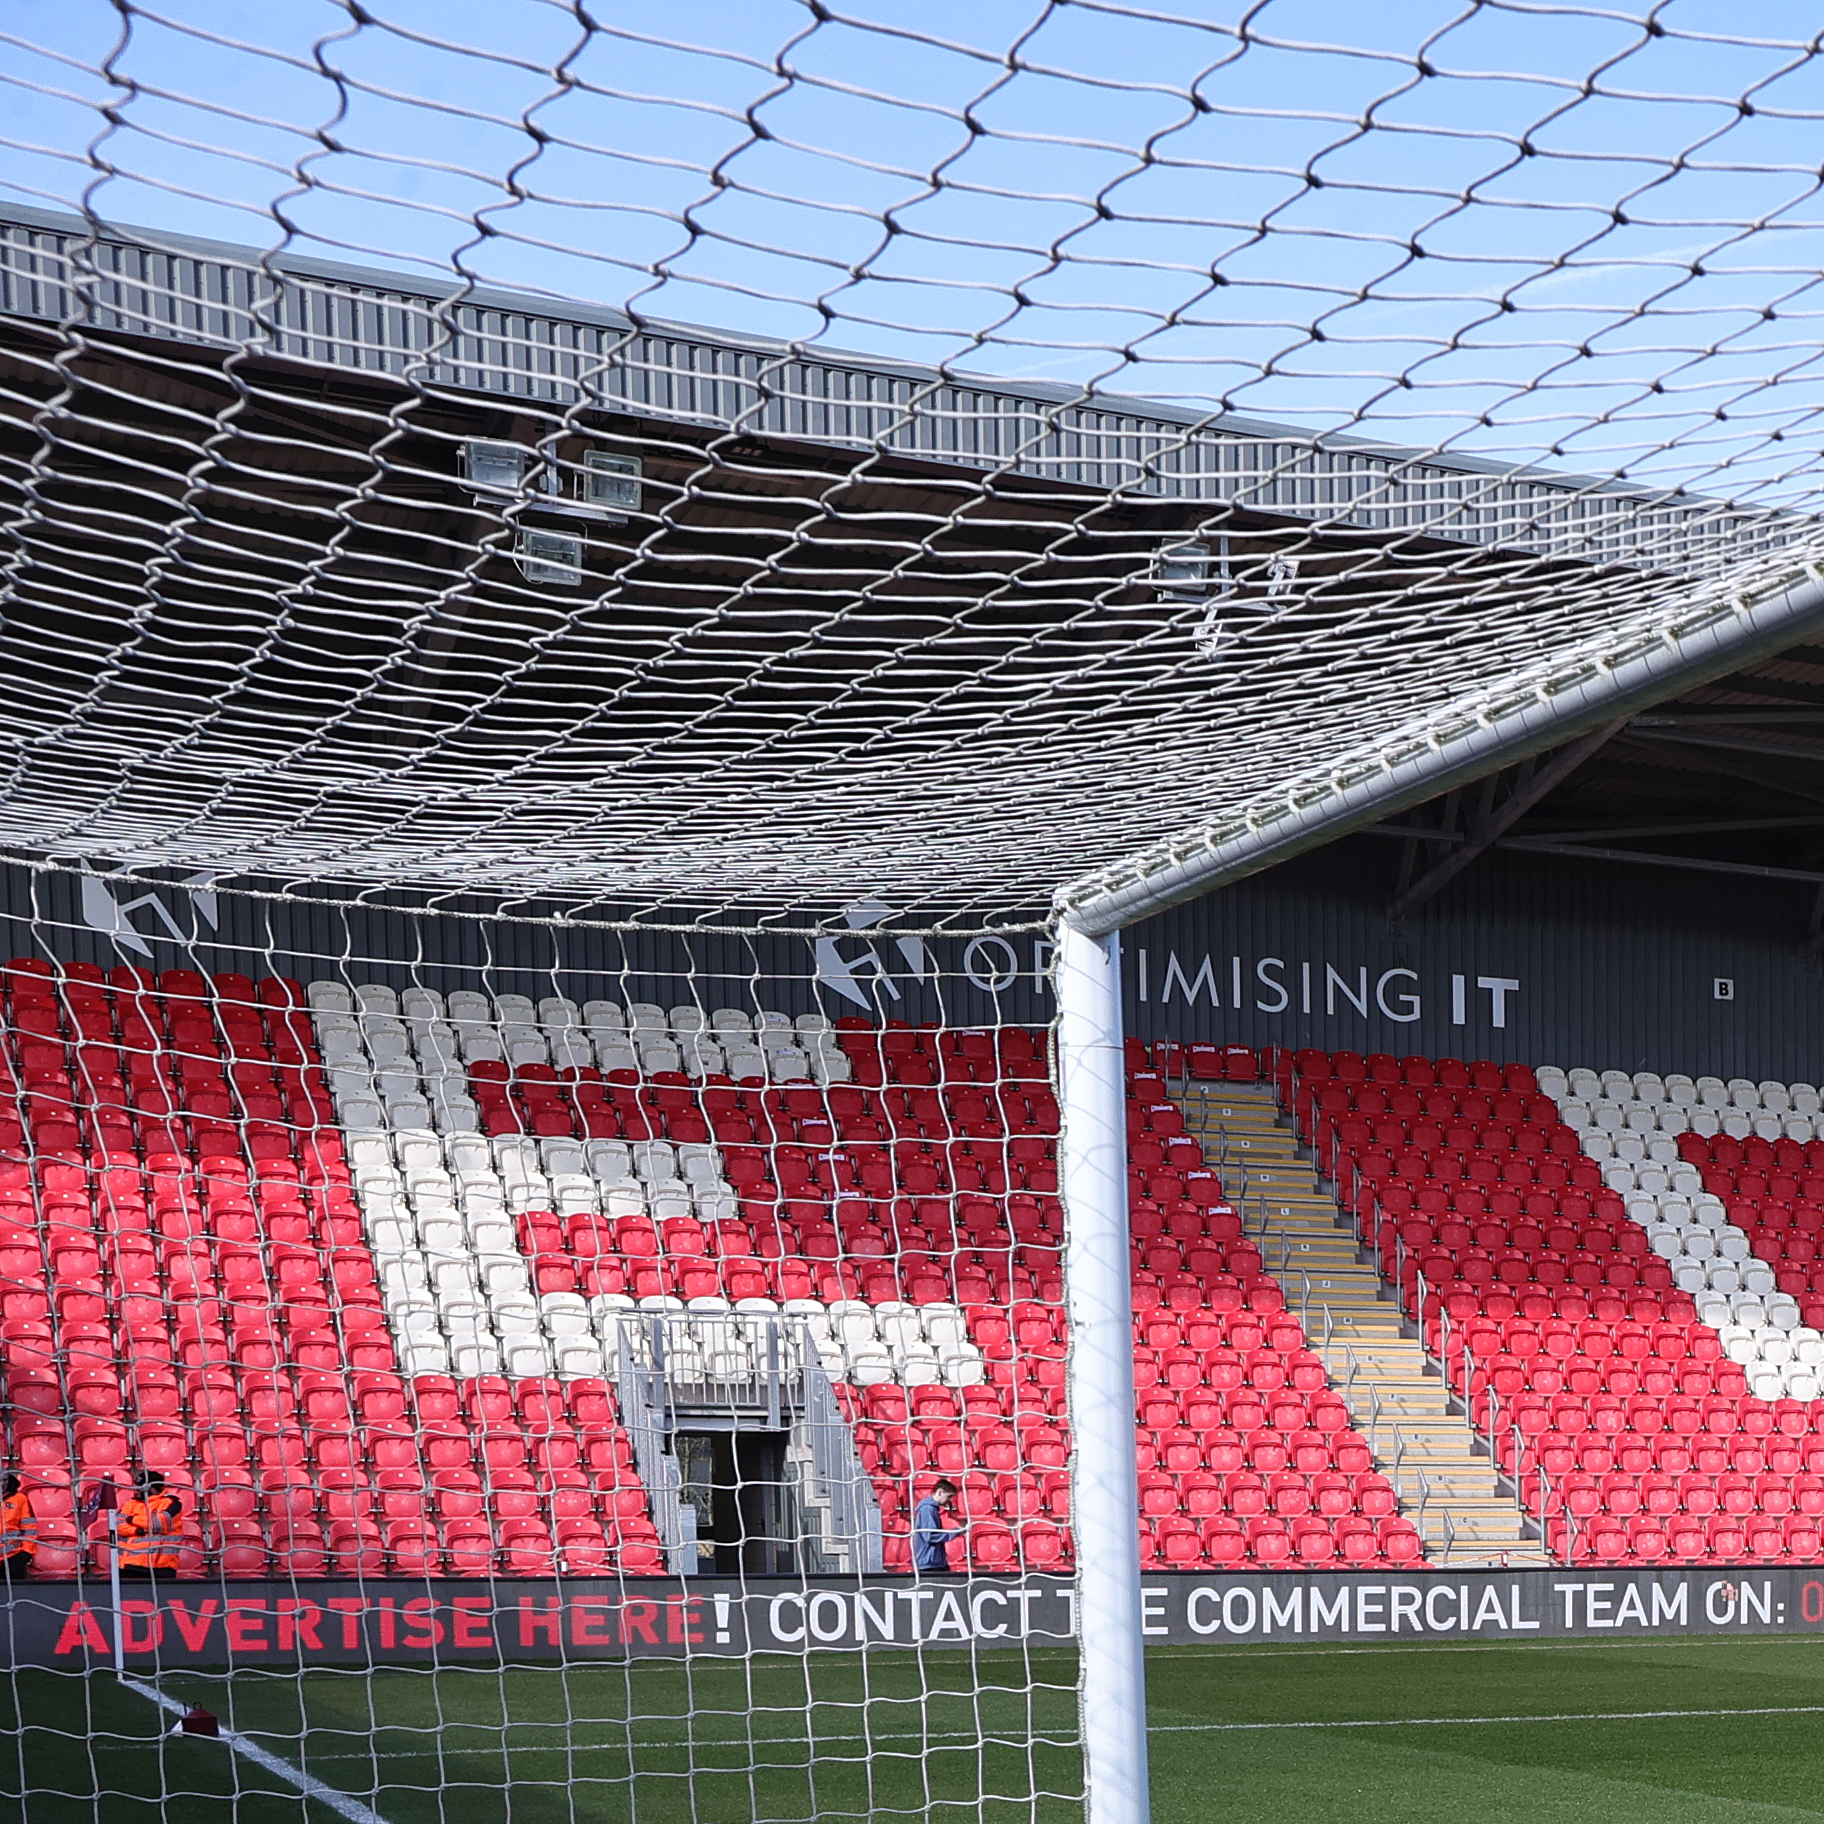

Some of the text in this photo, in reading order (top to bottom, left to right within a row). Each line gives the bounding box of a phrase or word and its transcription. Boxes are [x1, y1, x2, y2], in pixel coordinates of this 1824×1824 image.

[963, 935, 1520, 1029] OIMISING IT
[1718, 982, 1729, 997] B
[54, 1596, 496, 1655] ADVERTISE
[517, 1593, 731, 1650] HERE!
[768, 1588, 1041, 1644] CONTACT
[1042, 1586, 1168, 1636] TE
[1185, 1583, 1540, 1634] COMMERCIAL
[1553, 1581, 1688, 1629] TEAM
[1705, 1578, 1786, 1626] ON:
